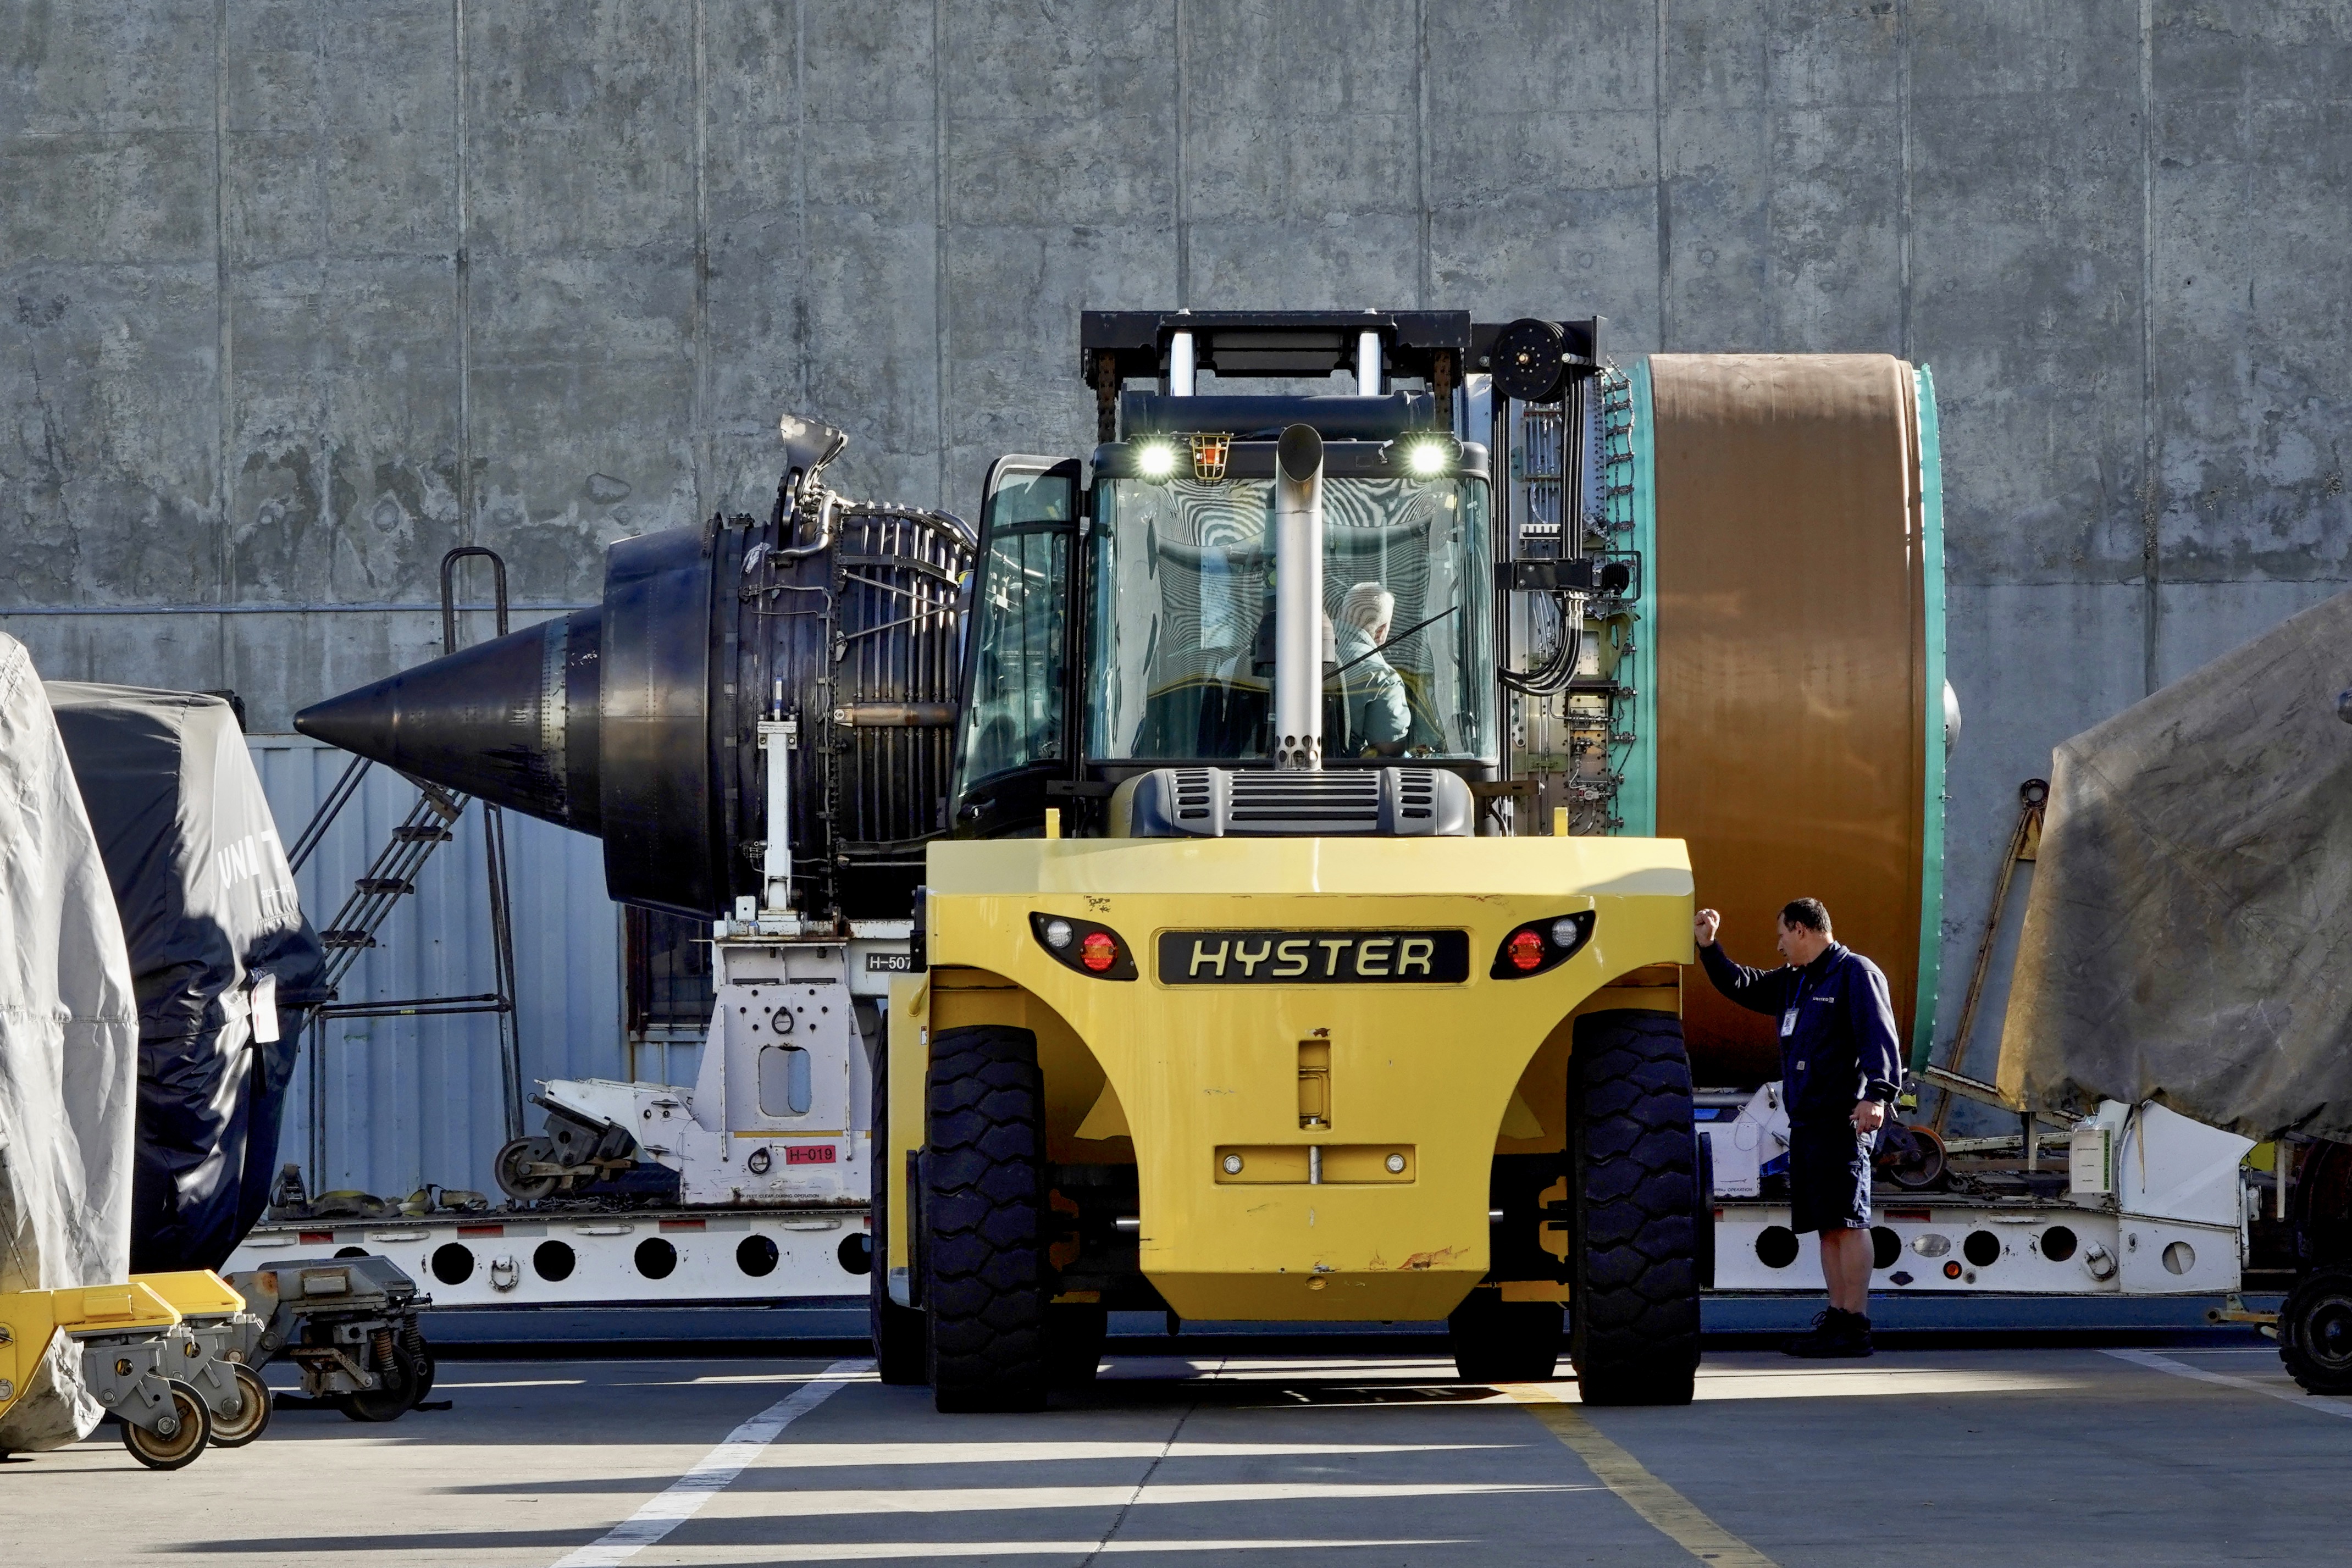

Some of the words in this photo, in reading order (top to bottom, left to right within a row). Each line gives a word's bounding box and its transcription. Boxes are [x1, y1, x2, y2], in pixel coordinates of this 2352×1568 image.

[870, 956, 911, 969] H-507
[1189, 939, 1434, 977] HYSTER
[789, 1148, 832, 1161] H-019
